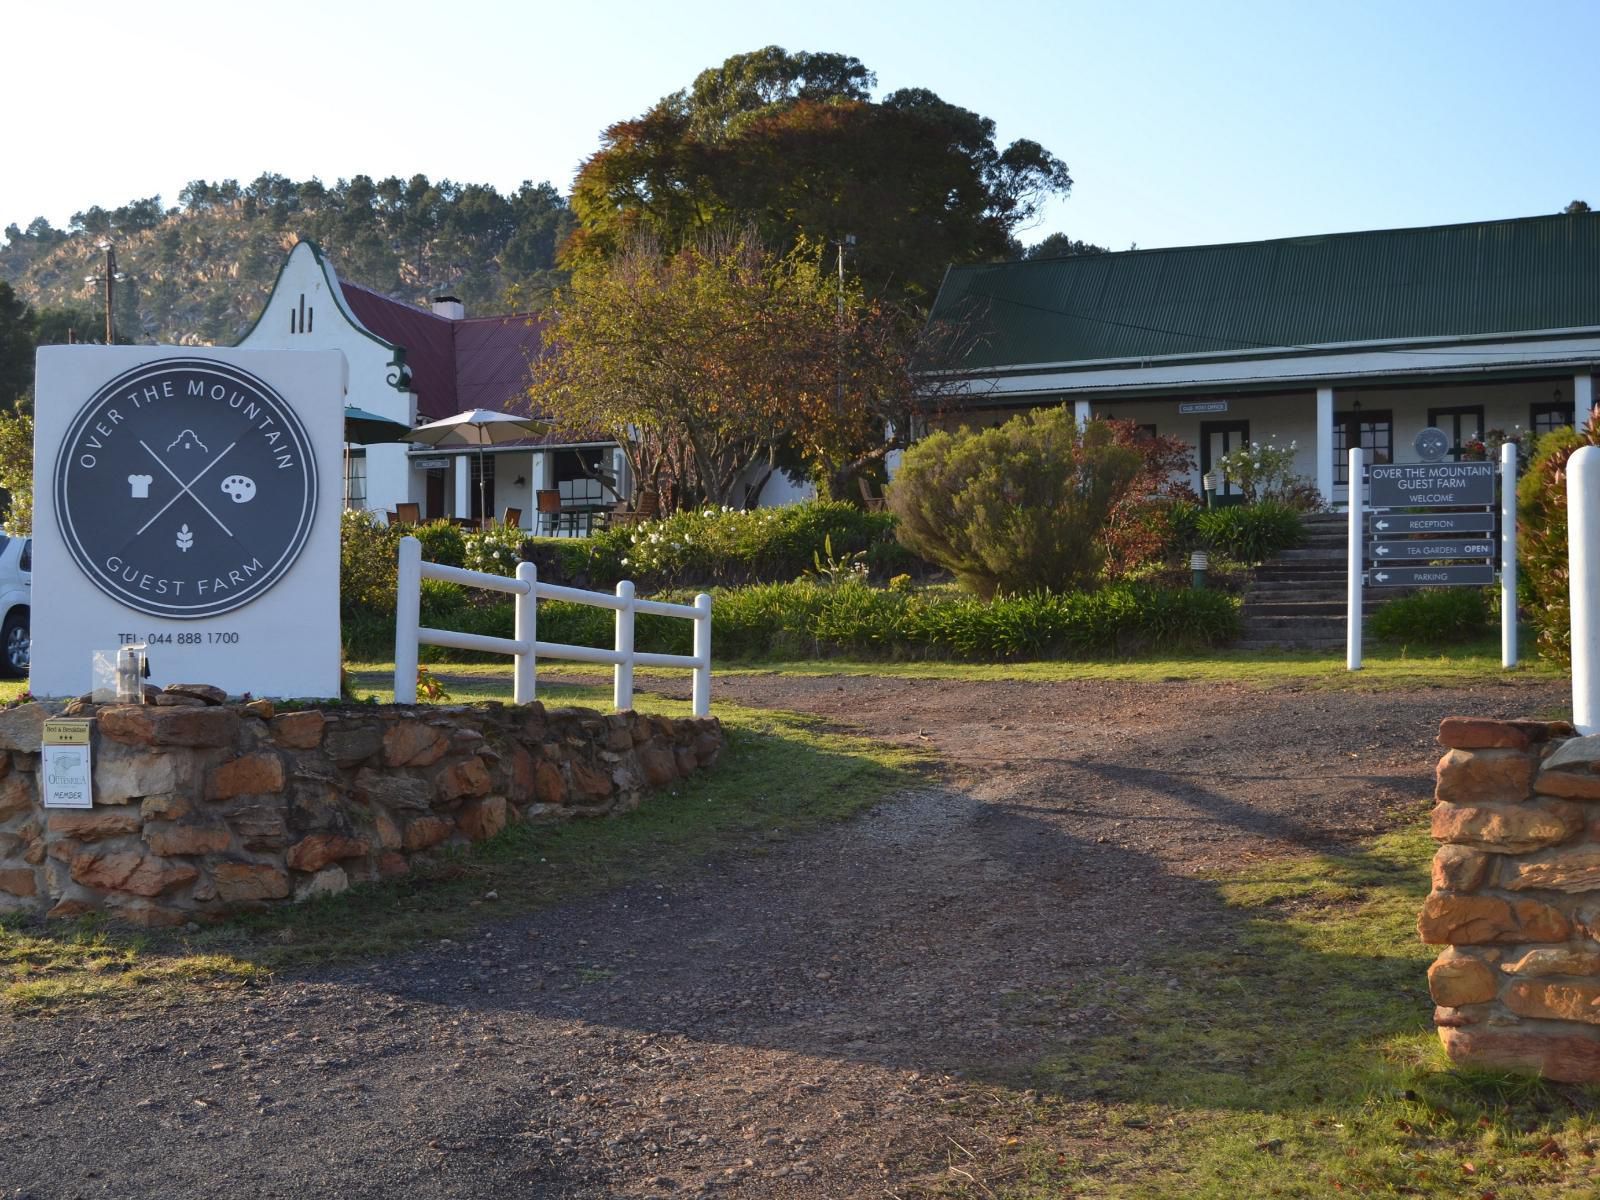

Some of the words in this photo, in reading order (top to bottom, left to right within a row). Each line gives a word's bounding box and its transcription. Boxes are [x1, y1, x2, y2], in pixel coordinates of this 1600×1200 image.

[81, 408, 124, 468] OVER
[128, 381, 174, 409] THE
[187, 379, 293, 469] MOUNTAIN
[1373, 468, 1402, 479] OVER
[1404, 468, 1425, 478] THE
[1428, 466, 1491, 478] MOUNTAIN
[1398, 479, 1433, 490] GUEST
[1437, 478, 1466, 489] FARM
[1409, 494, 1454, 503] WELCOME
[1410, 520, 1453, 529] RECEPTION
[1407, 547, 1422, 555] TEA
[1423, 546, 1456, 555] GARDEN
[1464, 544, 1488, 553] OPEN
[106, 556, 185, 596] GUEST
[198, 557, 263, 595] FARM
[1414, 573, 1448, 581] PARKING
[148, 632, 172, 645] 044
[177, 632, 202, 644] 888
[207, 631, 239, 644] 1700
[54, 791, 82, 800] MEMBER
